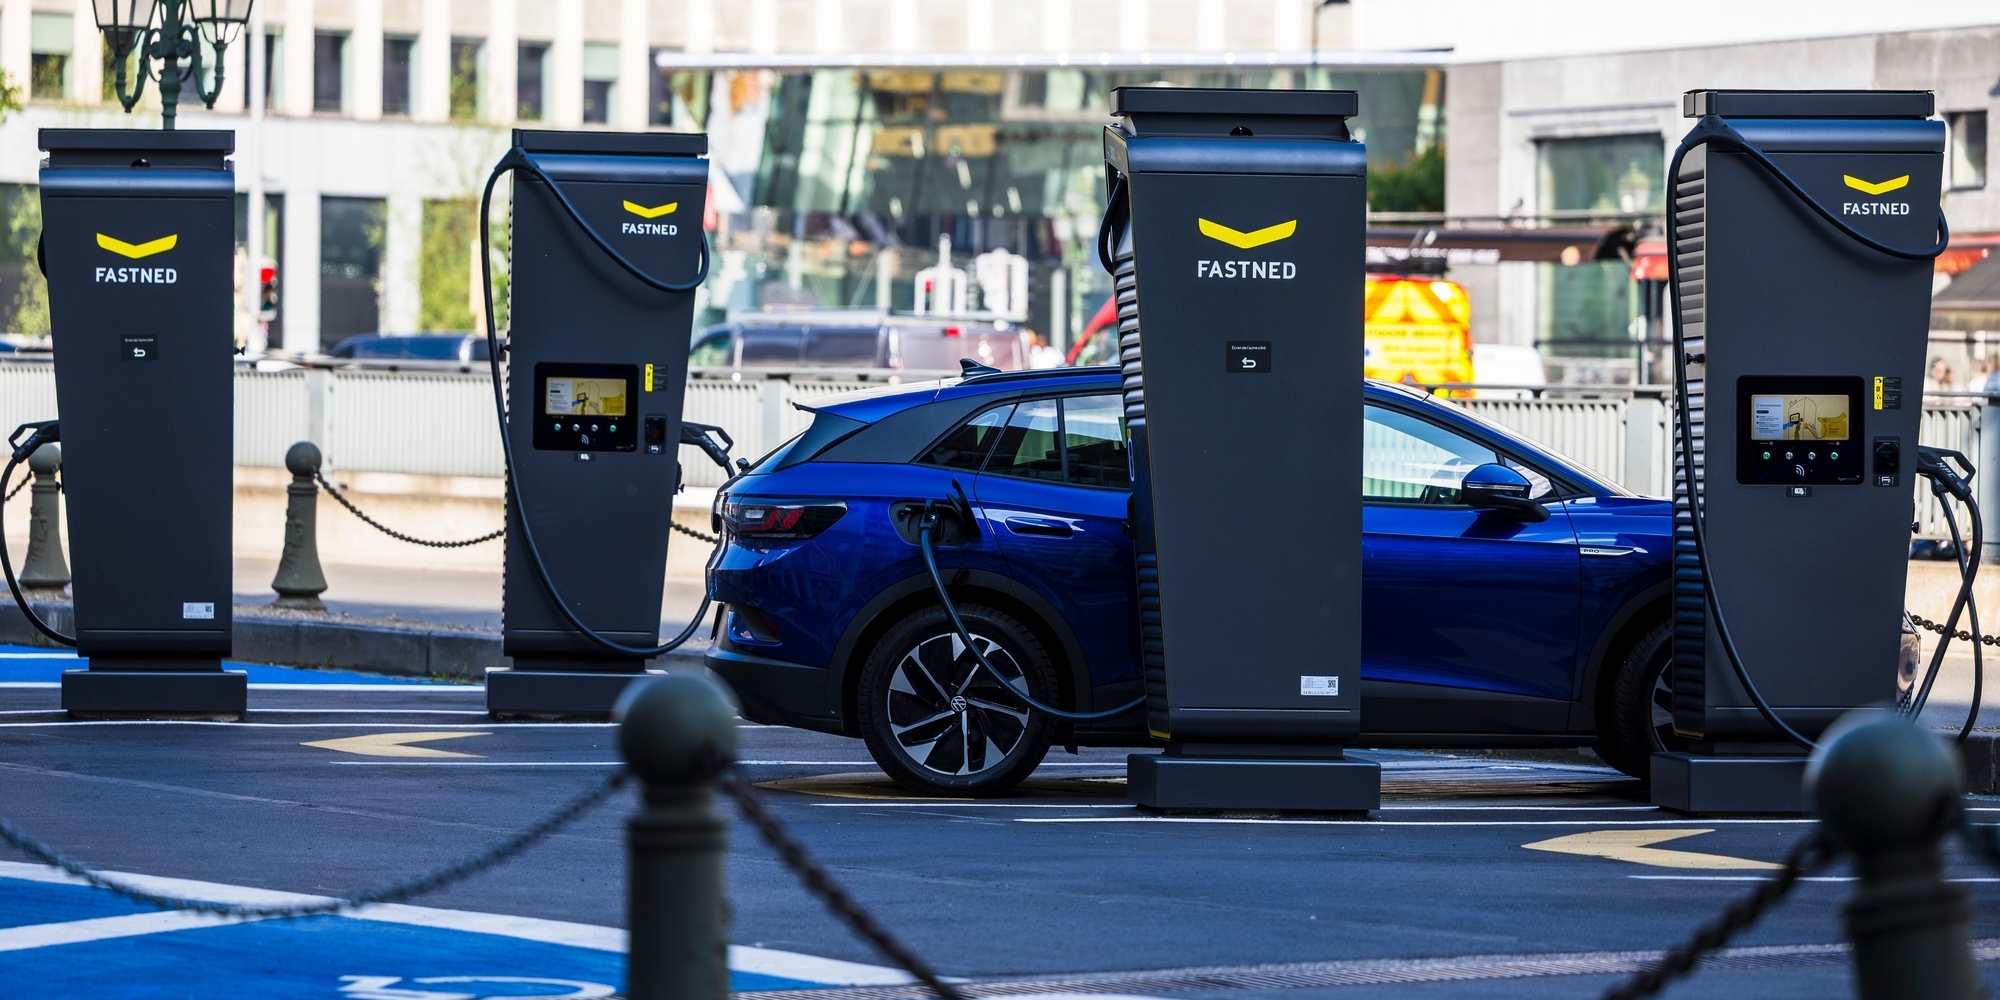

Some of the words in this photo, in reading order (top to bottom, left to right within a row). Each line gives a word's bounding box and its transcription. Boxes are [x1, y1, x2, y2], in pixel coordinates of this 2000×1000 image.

[1843, 202, 1910, 216] FASTNED
[621, 222, 678, 236] FASTNED
[95, 267, 178, 284] FASTNED
[1197, 259, 1297, 280] FASTNED
[1936, 462, 1957, 480] HPC
